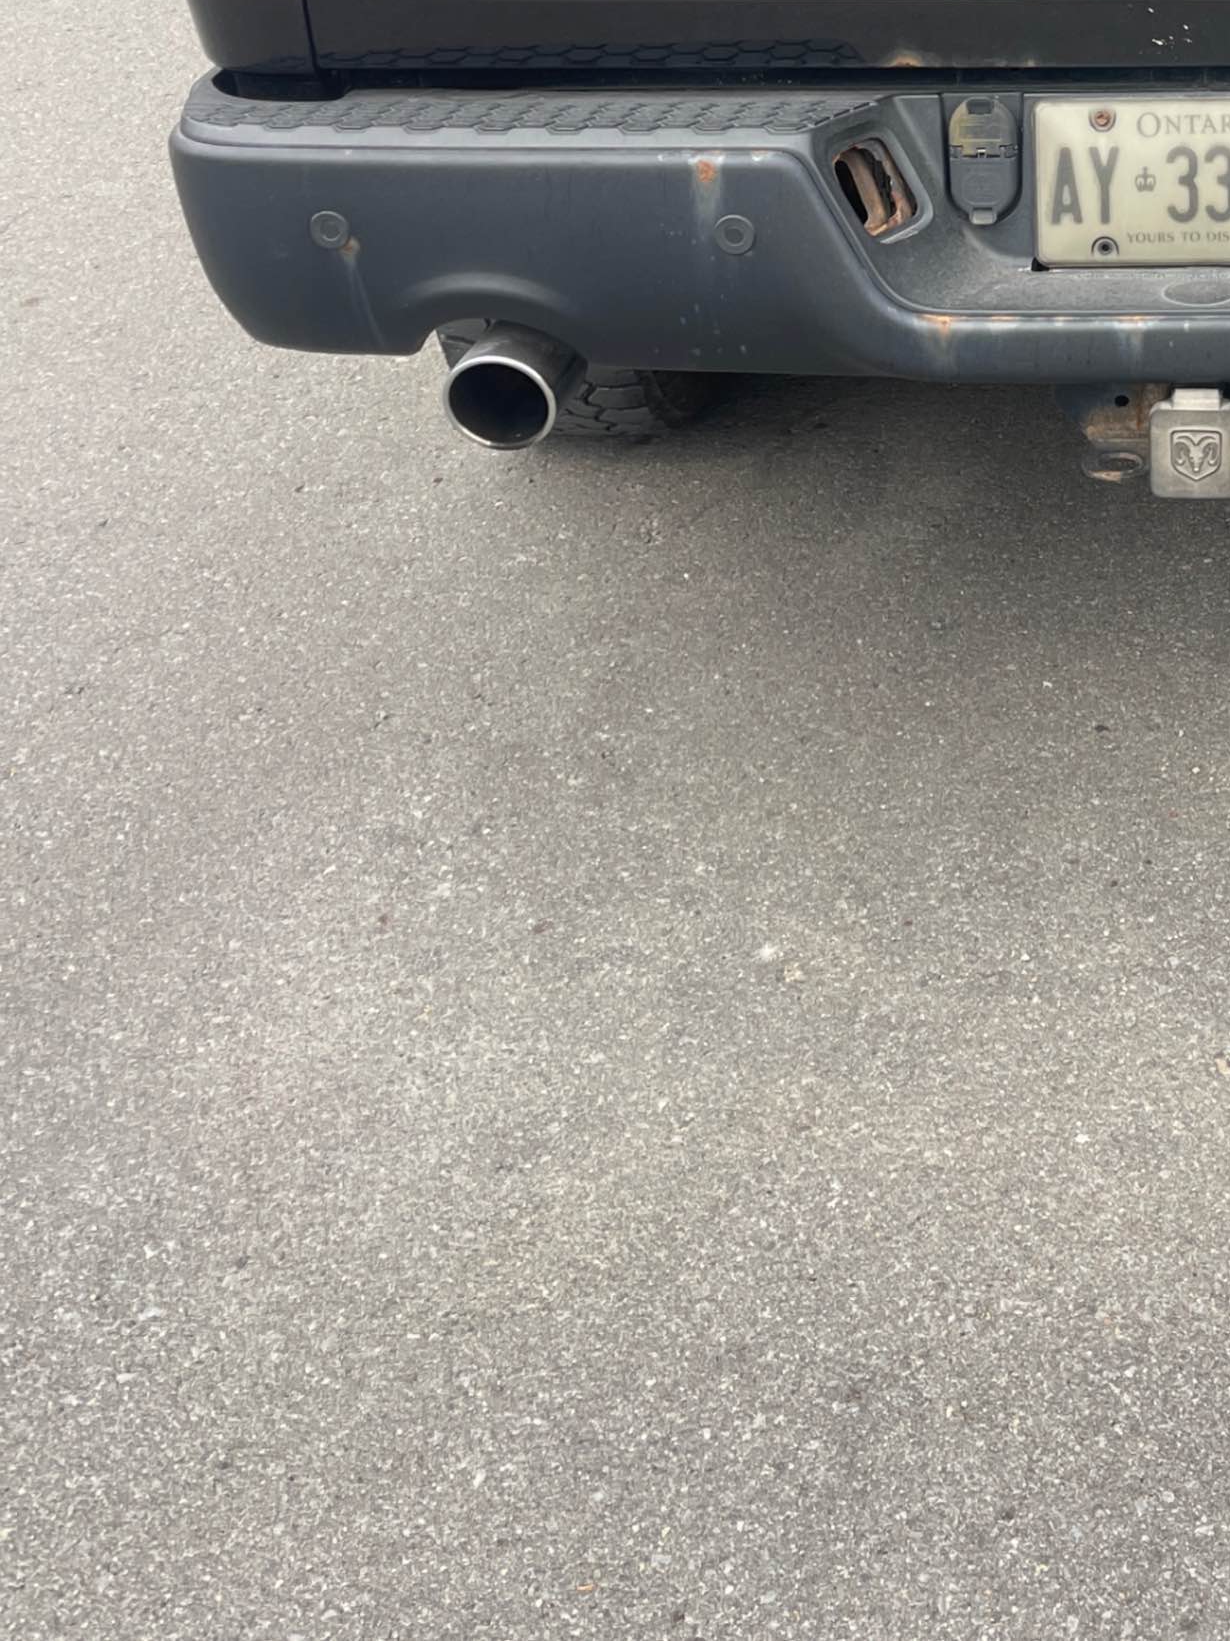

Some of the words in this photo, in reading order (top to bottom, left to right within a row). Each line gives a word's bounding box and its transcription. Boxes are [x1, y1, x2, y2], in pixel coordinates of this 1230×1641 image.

[1050, 145, 1120, 226] AY
[1126, 230, 1175, 244] YOURS
[1181, 230, 1201, 243] TO
